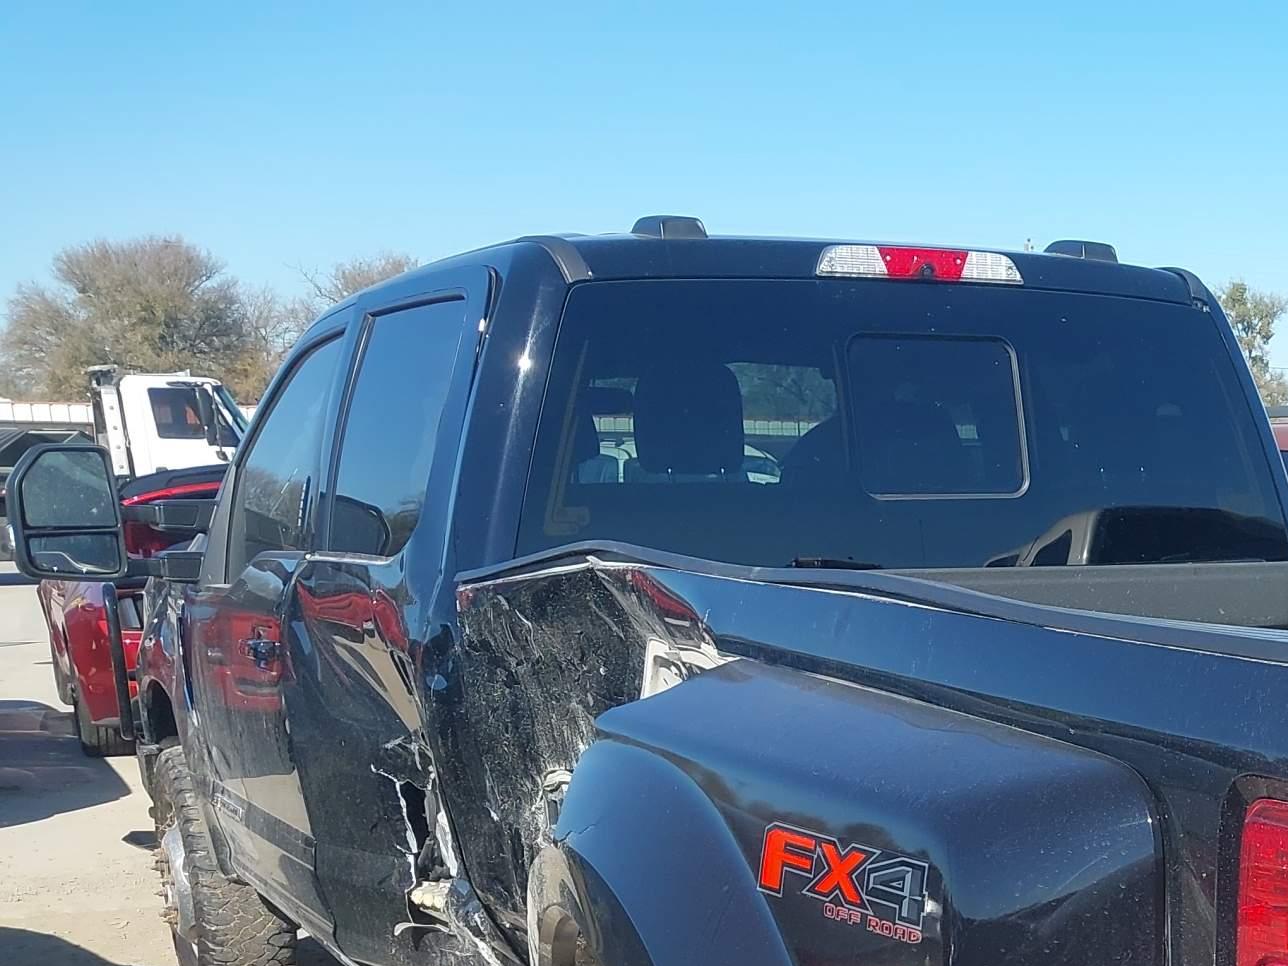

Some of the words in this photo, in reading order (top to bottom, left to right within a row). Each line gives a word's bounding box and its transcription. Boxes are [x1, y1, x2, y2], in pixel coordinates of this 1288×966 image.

[757, 821, 928, 930] FX4
[823, 903, 861, 924] OFF
[866, 917, 922, 943] ROAD
